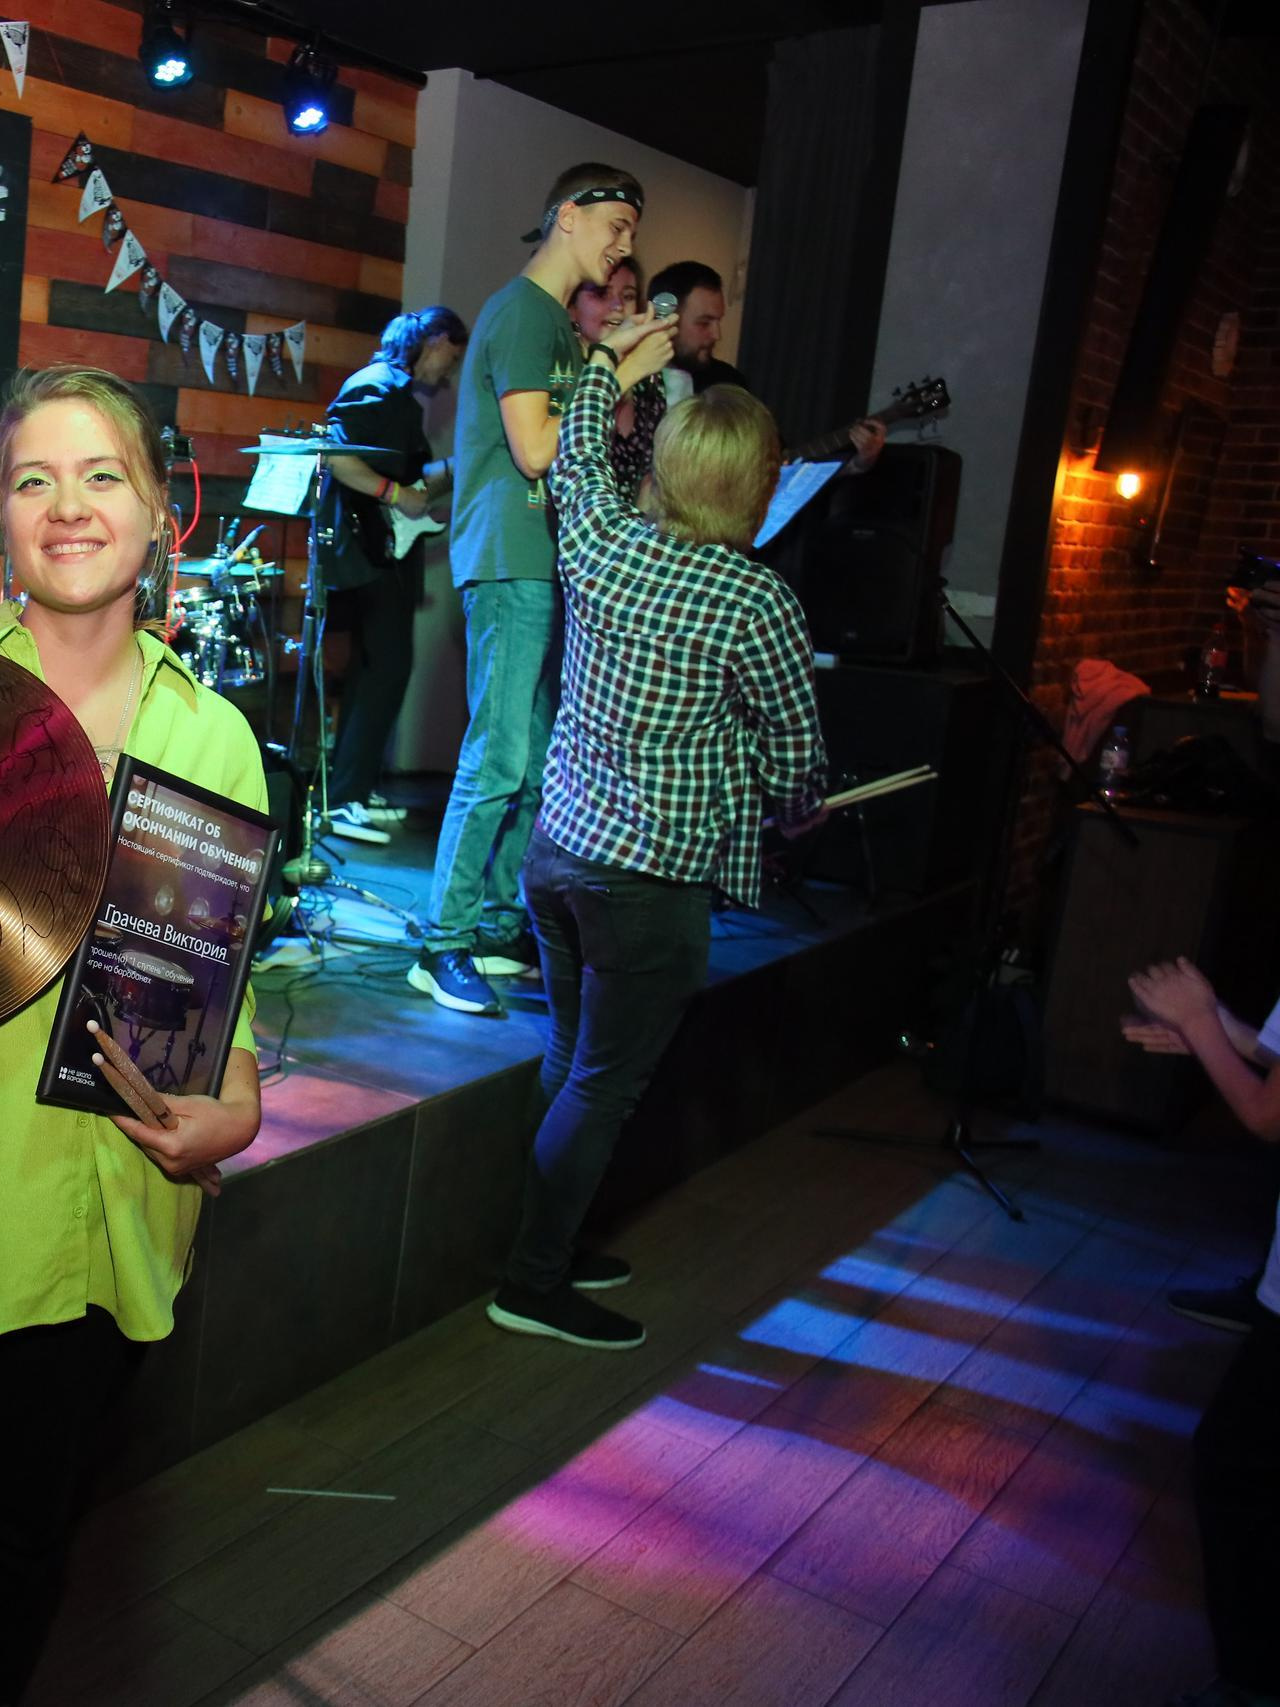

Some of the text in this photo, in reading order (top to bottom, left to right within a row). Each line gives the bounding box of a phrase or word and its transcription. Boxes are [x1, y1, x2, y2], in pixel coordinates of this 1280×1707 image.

[127, 790, 221, 839] СЕРТИФИКАТ ОБ
[117, 835, 250, 893] Настоящий сертификат подтверждает, что
[122, 810, 257, 875] ОКОНЧАНИИ ОБУЧЕНИЯ
[104, 903, 227, 961] Грачева Виктория
[103, 964, 113, 973] на
[113, 965, 152, 985] барабанах
[165, 969, 195, 985] обучения
